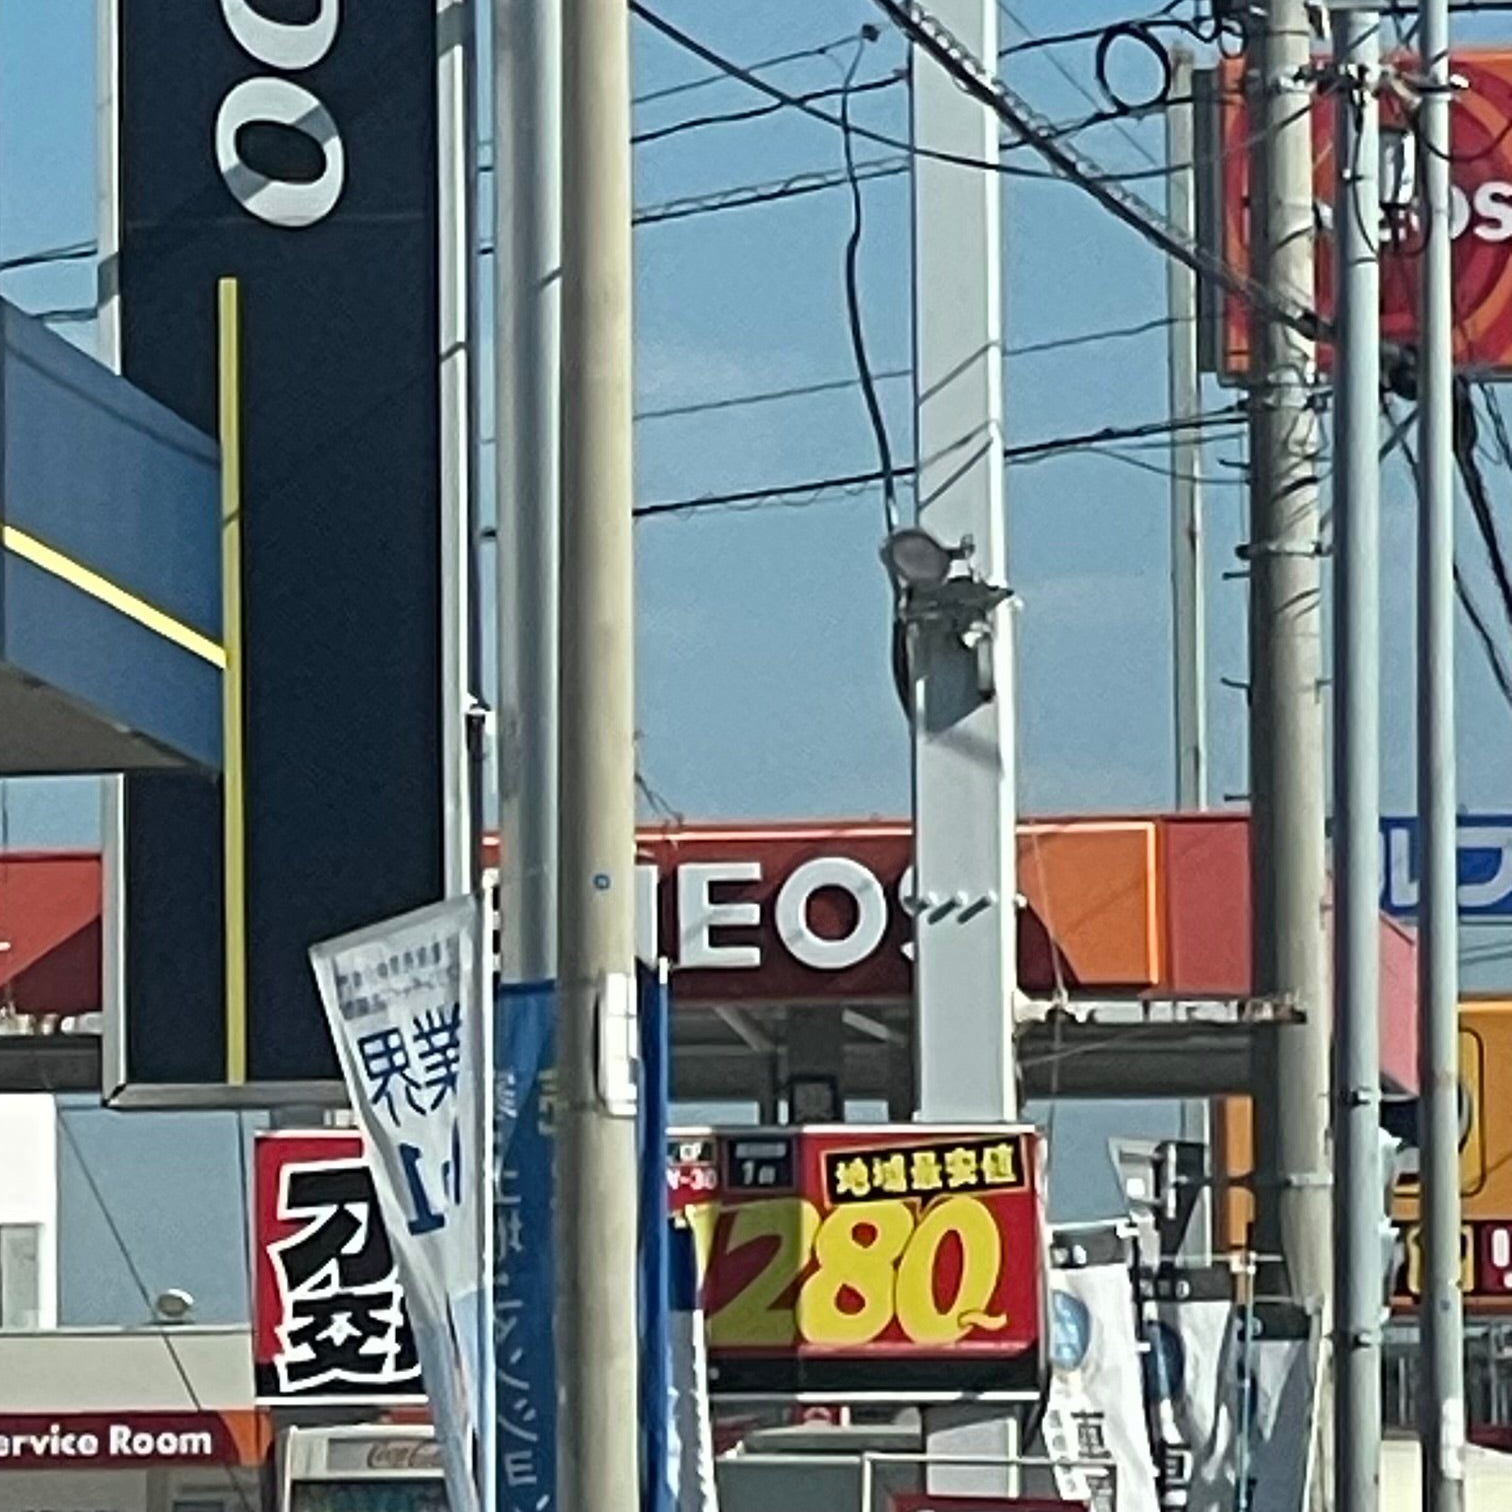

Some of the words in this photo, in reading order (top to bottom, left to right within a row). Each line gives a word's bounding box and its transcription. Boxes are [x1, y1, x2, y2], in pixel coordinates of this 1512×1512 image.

[835, 1142, 1019, 1197] 地域最安値
[109, 1424, 213, 1456] Room
